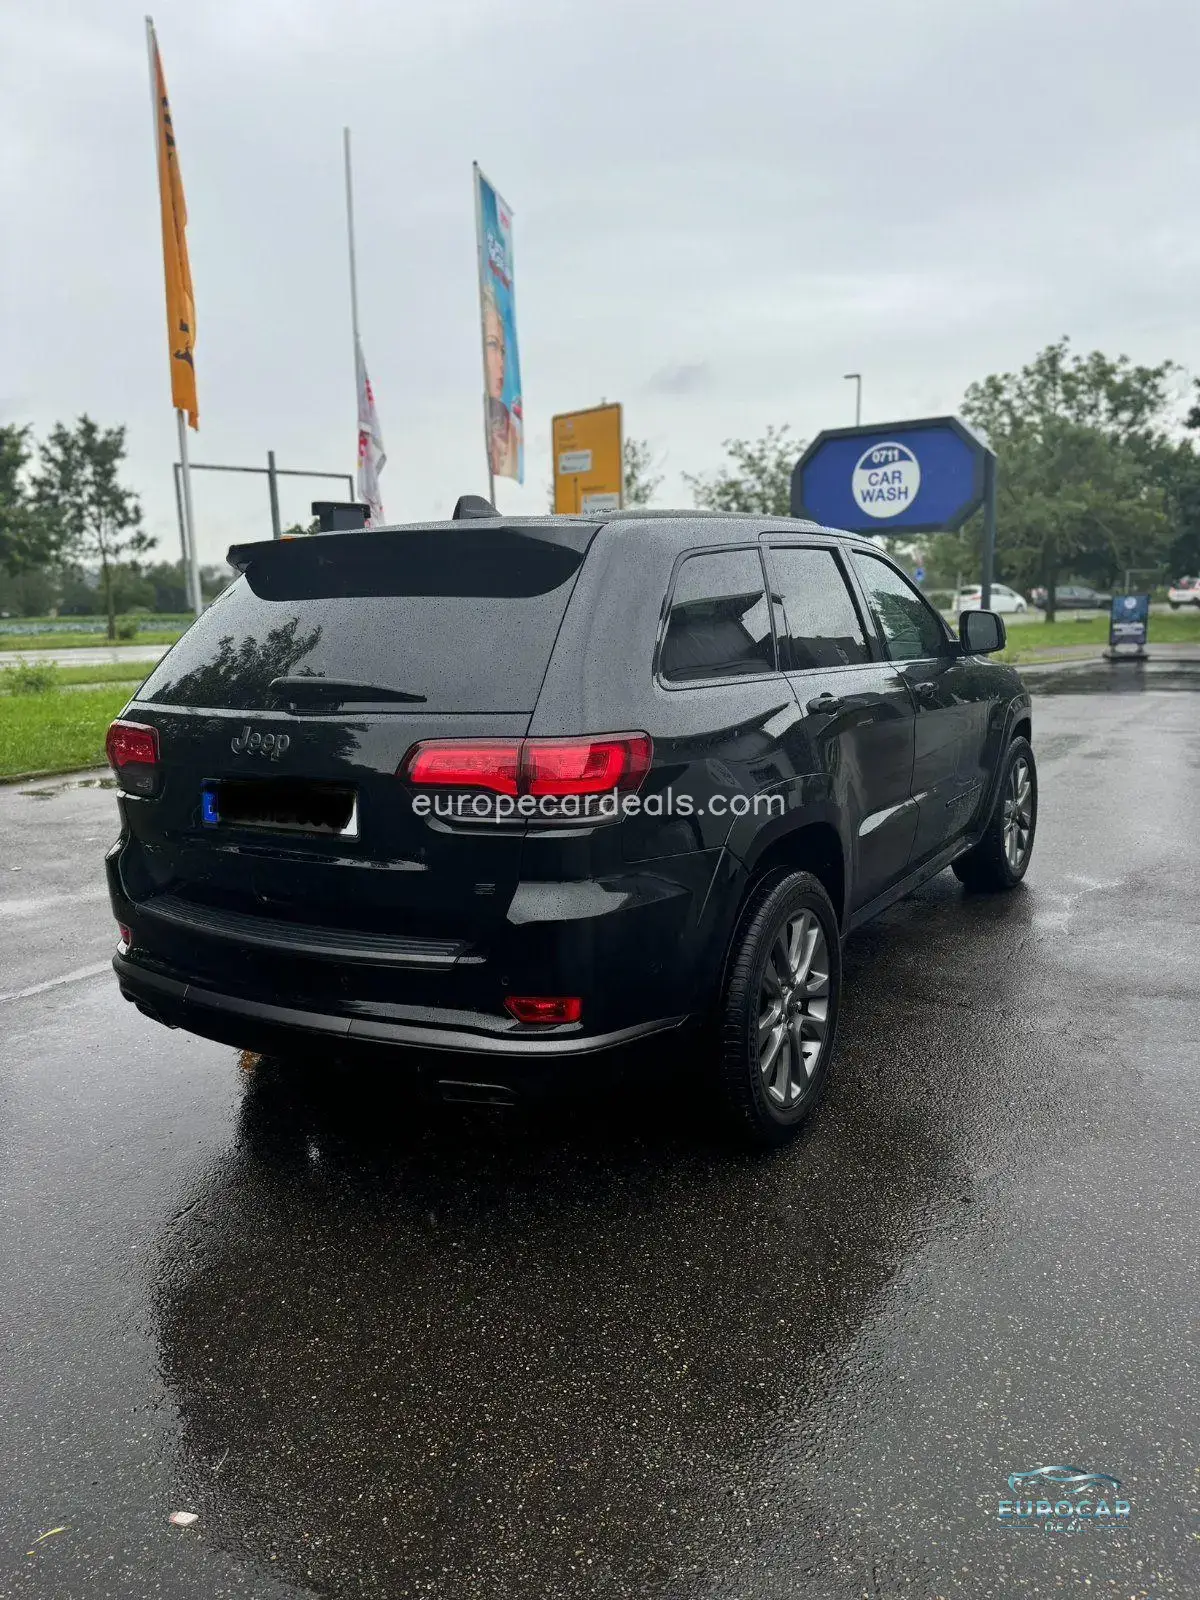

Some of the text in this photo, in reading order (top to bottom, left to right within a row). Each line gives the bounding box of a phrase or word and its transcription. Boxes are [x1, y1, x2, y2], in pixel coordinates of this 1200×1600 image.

[872, 449, 899, 463] 0711
[868, 471, 902, 487] CAR
[861, 486, 908, 502] WASH
[231, 726, 290, 761] Jeep
